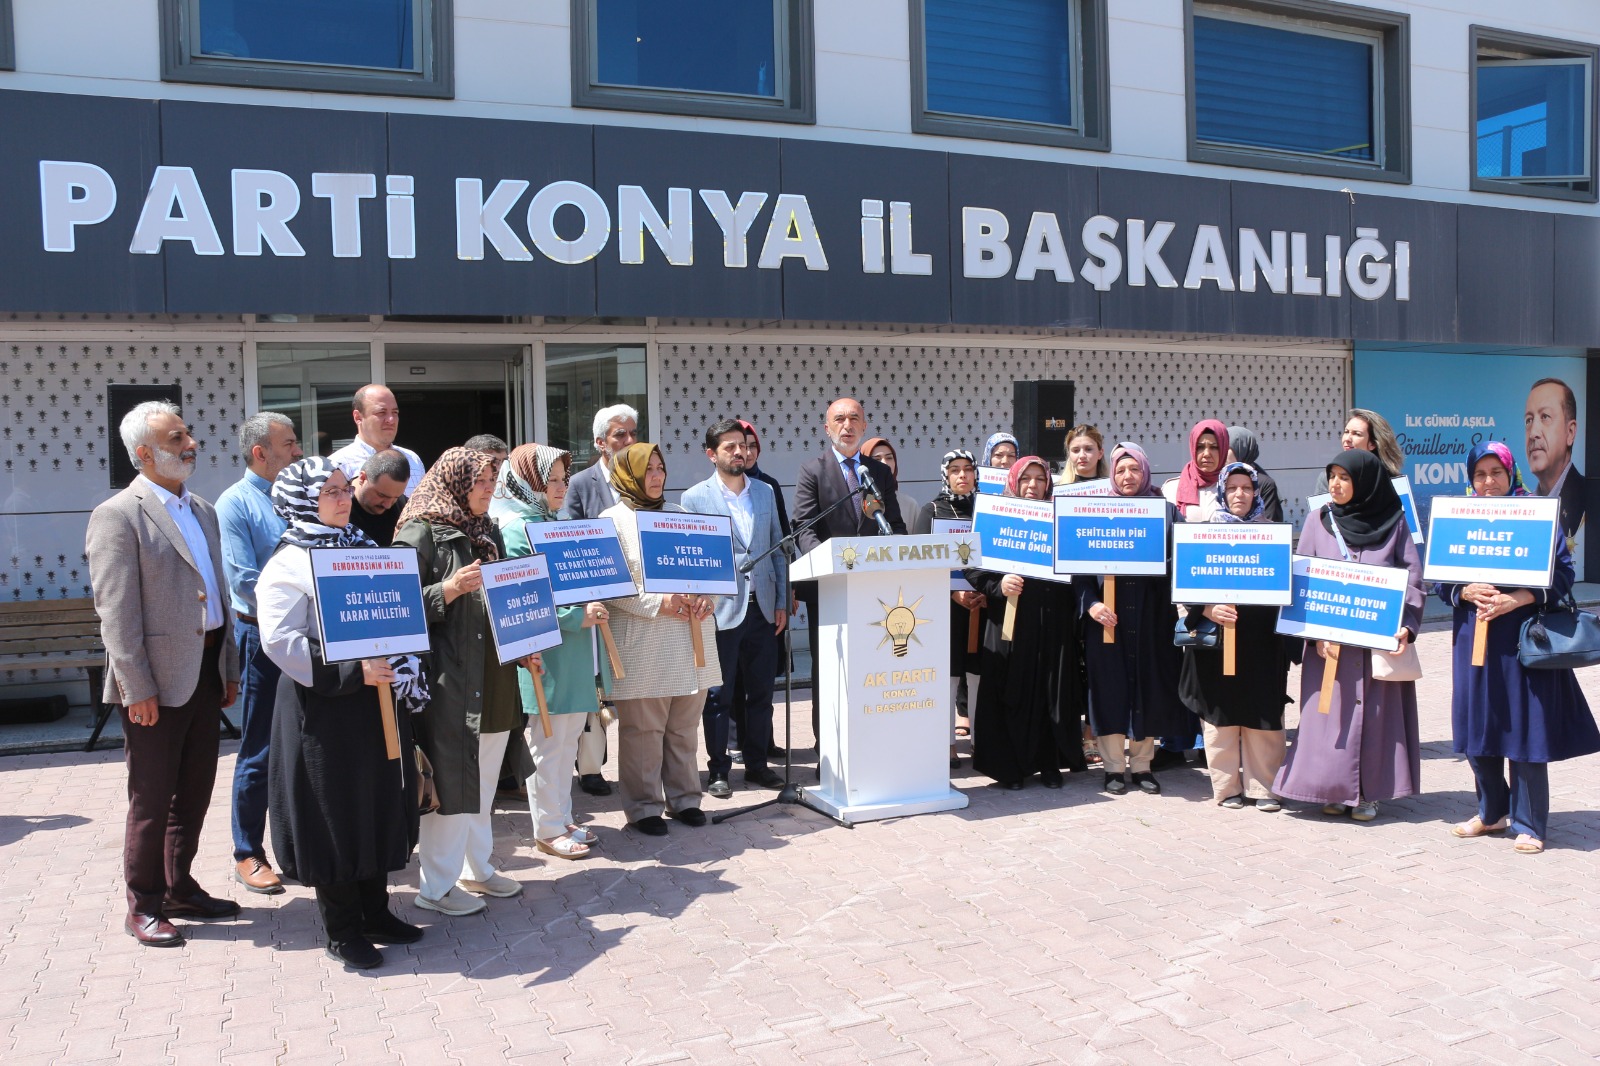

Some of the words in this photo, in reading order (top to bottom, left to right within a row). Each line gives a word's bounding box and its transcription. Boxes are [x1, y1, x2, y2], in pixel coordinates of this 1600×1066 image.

[39, 160, 416, 259] PARTİ
[455, 178, 829, 271] KONYA
[860, 199, 933, 276] İL
[962, 206, 1410, 301] BAŞKANLIĞI
[1406, 414, 1422, 427] İLK
[1424, 414, 1460, 427] GÜNKÜ
[1462, 416, 1496, 429] AŞKLA
[1414, 462, 1469, 484] KONY
[1000, 527, 1028, 539] MİLLET
[1030, 530, 1048, 542] İÇİN
[1076, 527, 1126, 538] ŞEHİTLERİN
[1128, 528, 1146, 538] PİRİ
[1467, 528, 1514, 541] MİLLET
[674, 546, 703, 555] YETER
[992, 537, 1026, 550] VERİLEN
[1028, 542, 1052, 554] ÖMÜR
[1088, 540, 1134, 549] MENDERES
[1449, 544, 1466, 554] NE
[1469, 545, 1511, 556] DERSE
[1514, 547, 1528, 557] O!
[563, 548, 580, 559] MİLLİ
[581, 548, 600, 556] İRADE
[865, 546, 893, 562] AK
[898, 544, 950, 561] PARTİ
[1206, 554, 1259, 564] DEMOKRASİ
[555, 562, 568, 570] TEK
[568, 558, 587, 569] PARTİ
[588, 556, 614, 568] REJİMİNİ
[657, 555, 675, 566] SÖZ
[678, 556, 722, 567] MİLLETİN!
[559, 571, 589, 581] ORTADAN
[589, 568, 618, 578] KALDIRDI
[1191, 566, 1222, 576] ÇINARI
[1225, 567, 1275, 576] MENDERES
[346, 592, 362, 605] SÖZ
[364, 589, 401, 604] MİLLETİN
[507, 597, 521, 609] SON
[522, 591, 538, 606] SÖZÜ
[1300, 589, 1351, 604] BASKILARA
[1354, 596, 1386, 610] BOYUN
[340, 610, 369, 622] KARAR
[371, 605, 410, 620] MİLLETİN!
[500, 613, 524, 628] MİLLET
[526, 607, 551, 621] SÖYLER!
[1304, 601, 1348, 616] EĞMEYEN
[1350, 607, 1378, 621] LİDER
[864, 672, 888, 688] AK
[892, 667, 936, 685] PARTİ
[883, 688, 917, 699] KONYA
[864, 704, 873, 714] İL
[876, 698, 935, 713] BAŞKANLIĞI
